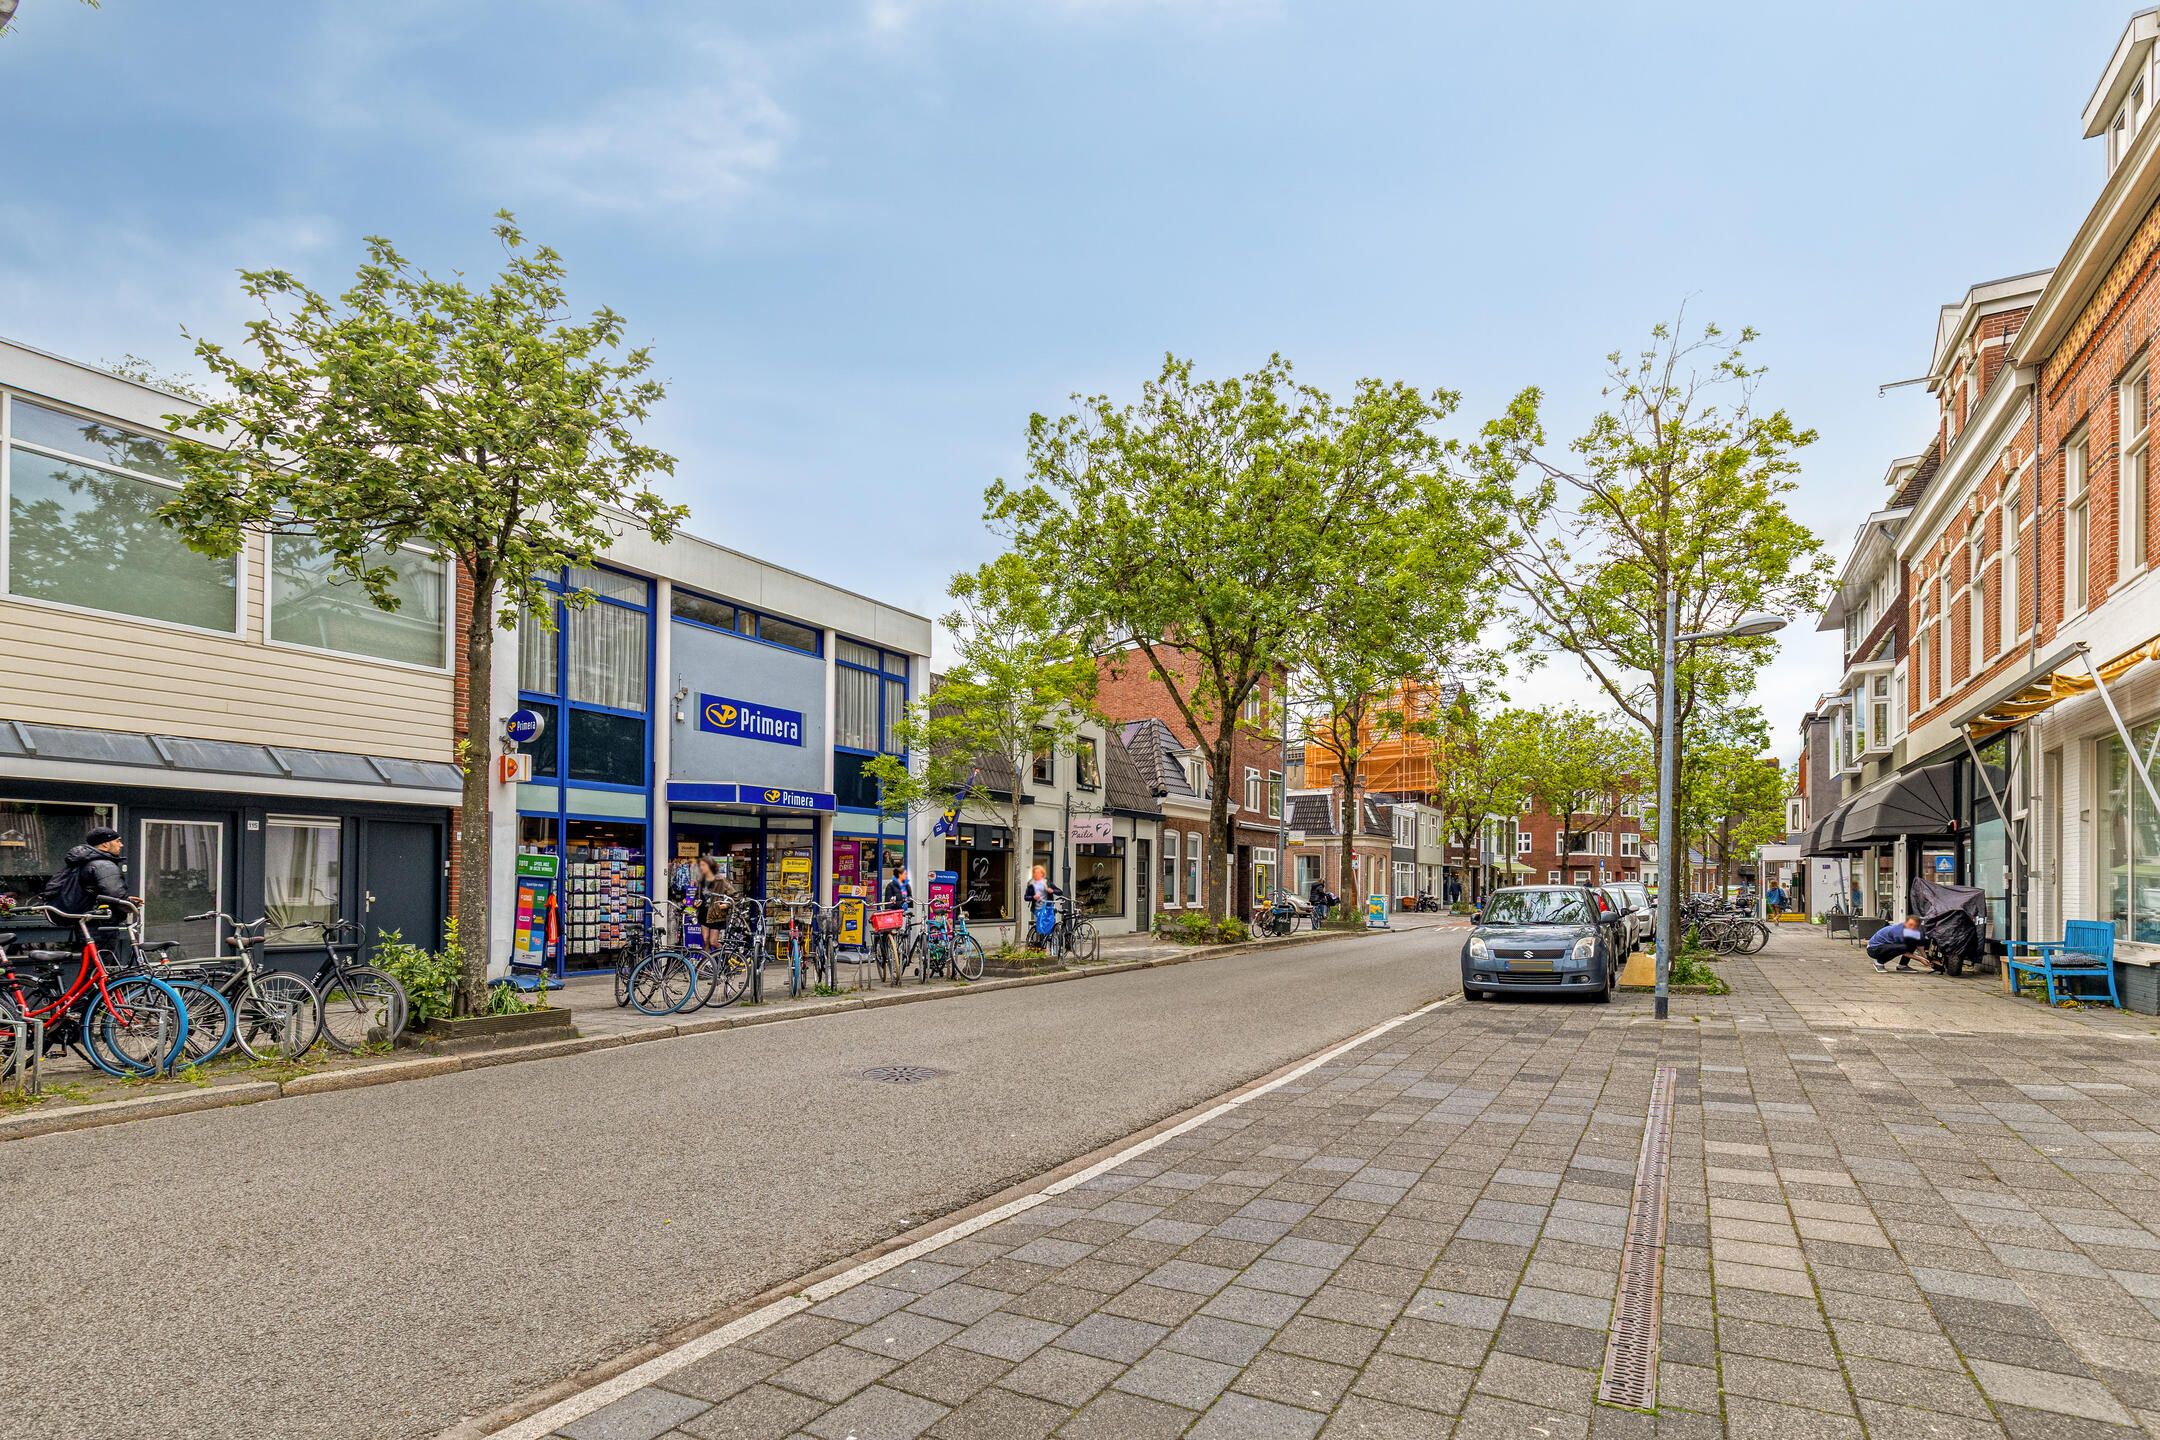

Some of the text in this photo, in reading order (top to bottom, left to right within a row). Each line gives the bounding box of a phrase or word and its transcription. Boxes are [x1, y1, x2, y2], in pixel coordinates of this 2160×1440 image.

[517, 720, 535, 731] Primera
[741, 708, 798, 739] Primera
[783, 791, 813, 807] Primera
[1071, 830, 1093, 839] Pailin
